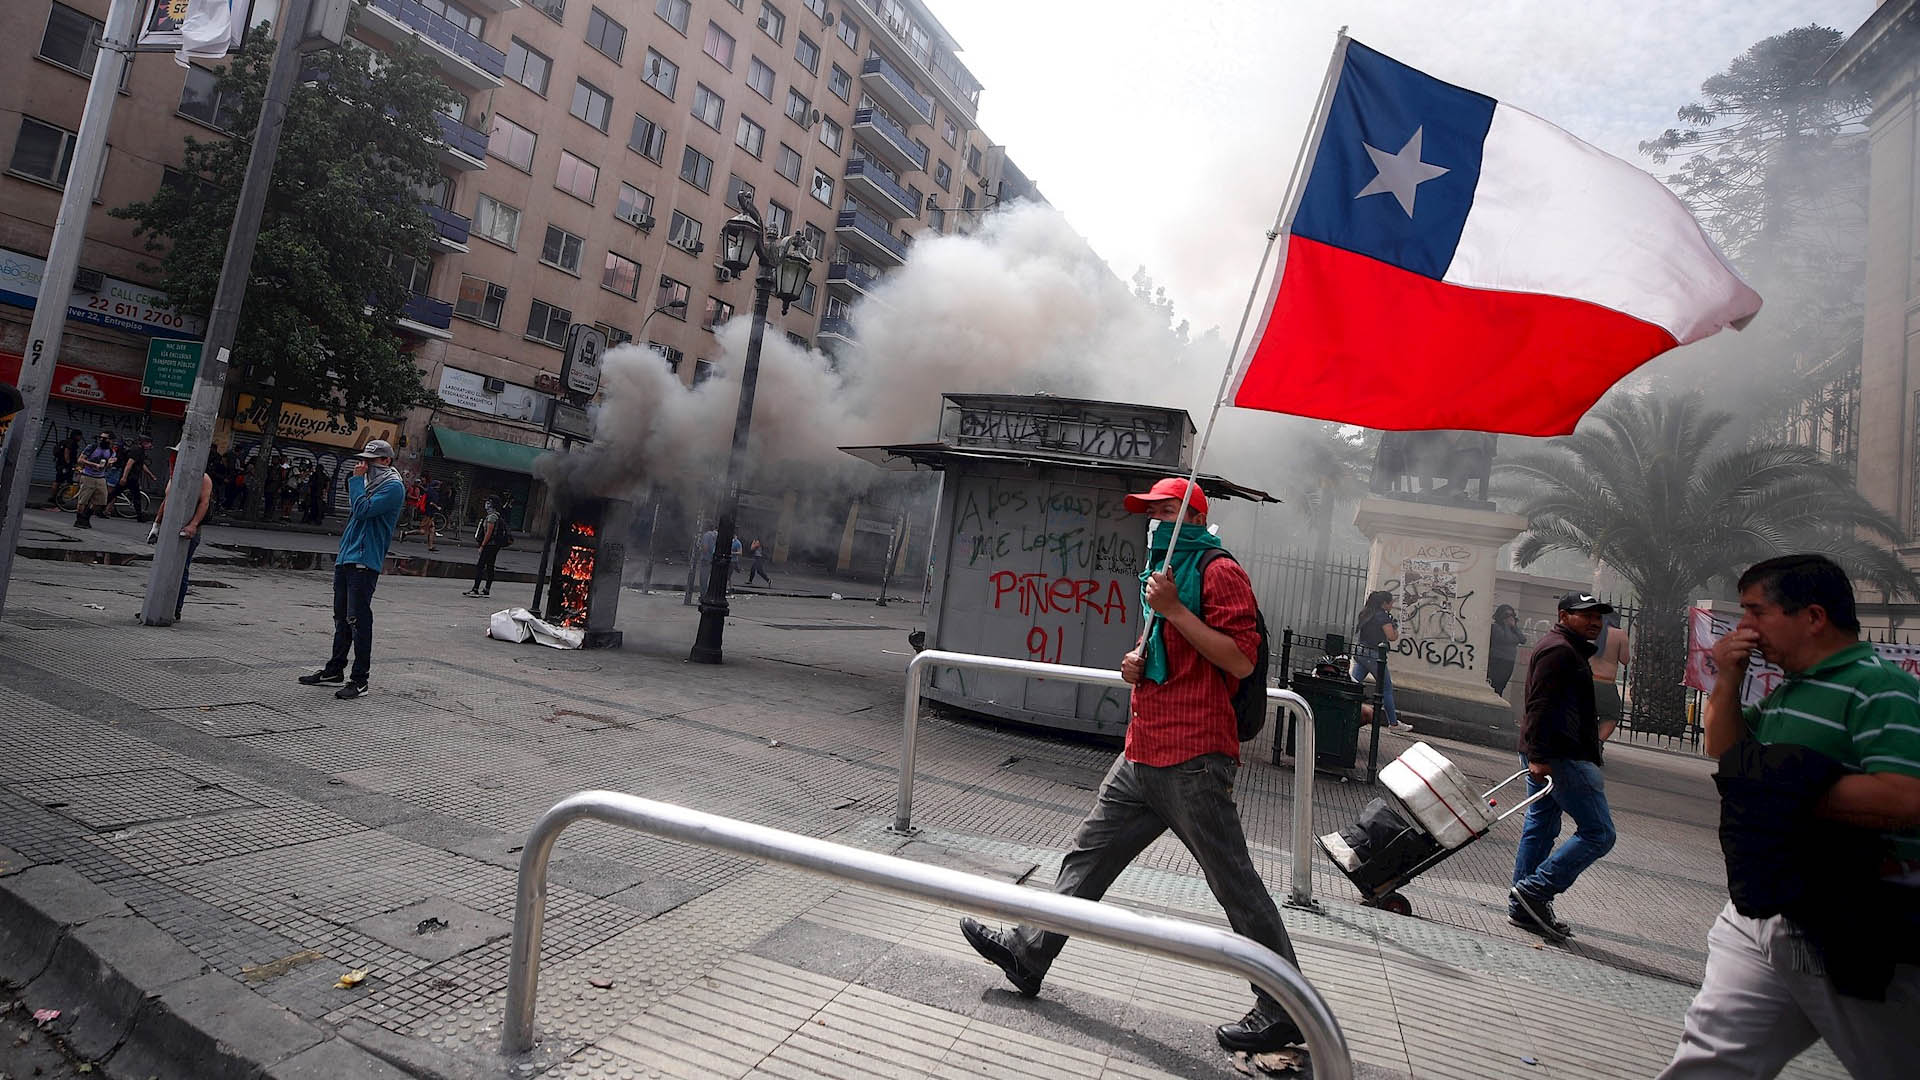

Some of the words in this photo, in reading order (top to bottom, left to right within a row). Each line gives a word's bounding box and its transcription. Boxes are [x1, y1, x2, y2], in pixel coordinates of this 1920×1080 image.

[110, 286, 133, 301] CALL
[87, 295, 109, 312] 22
[115, 302, 138, 318] 611
[143, 309, 184, 328] 2700
[103, 315, 143, 332] Entrepiso
[957, 490, 984, 534] A
